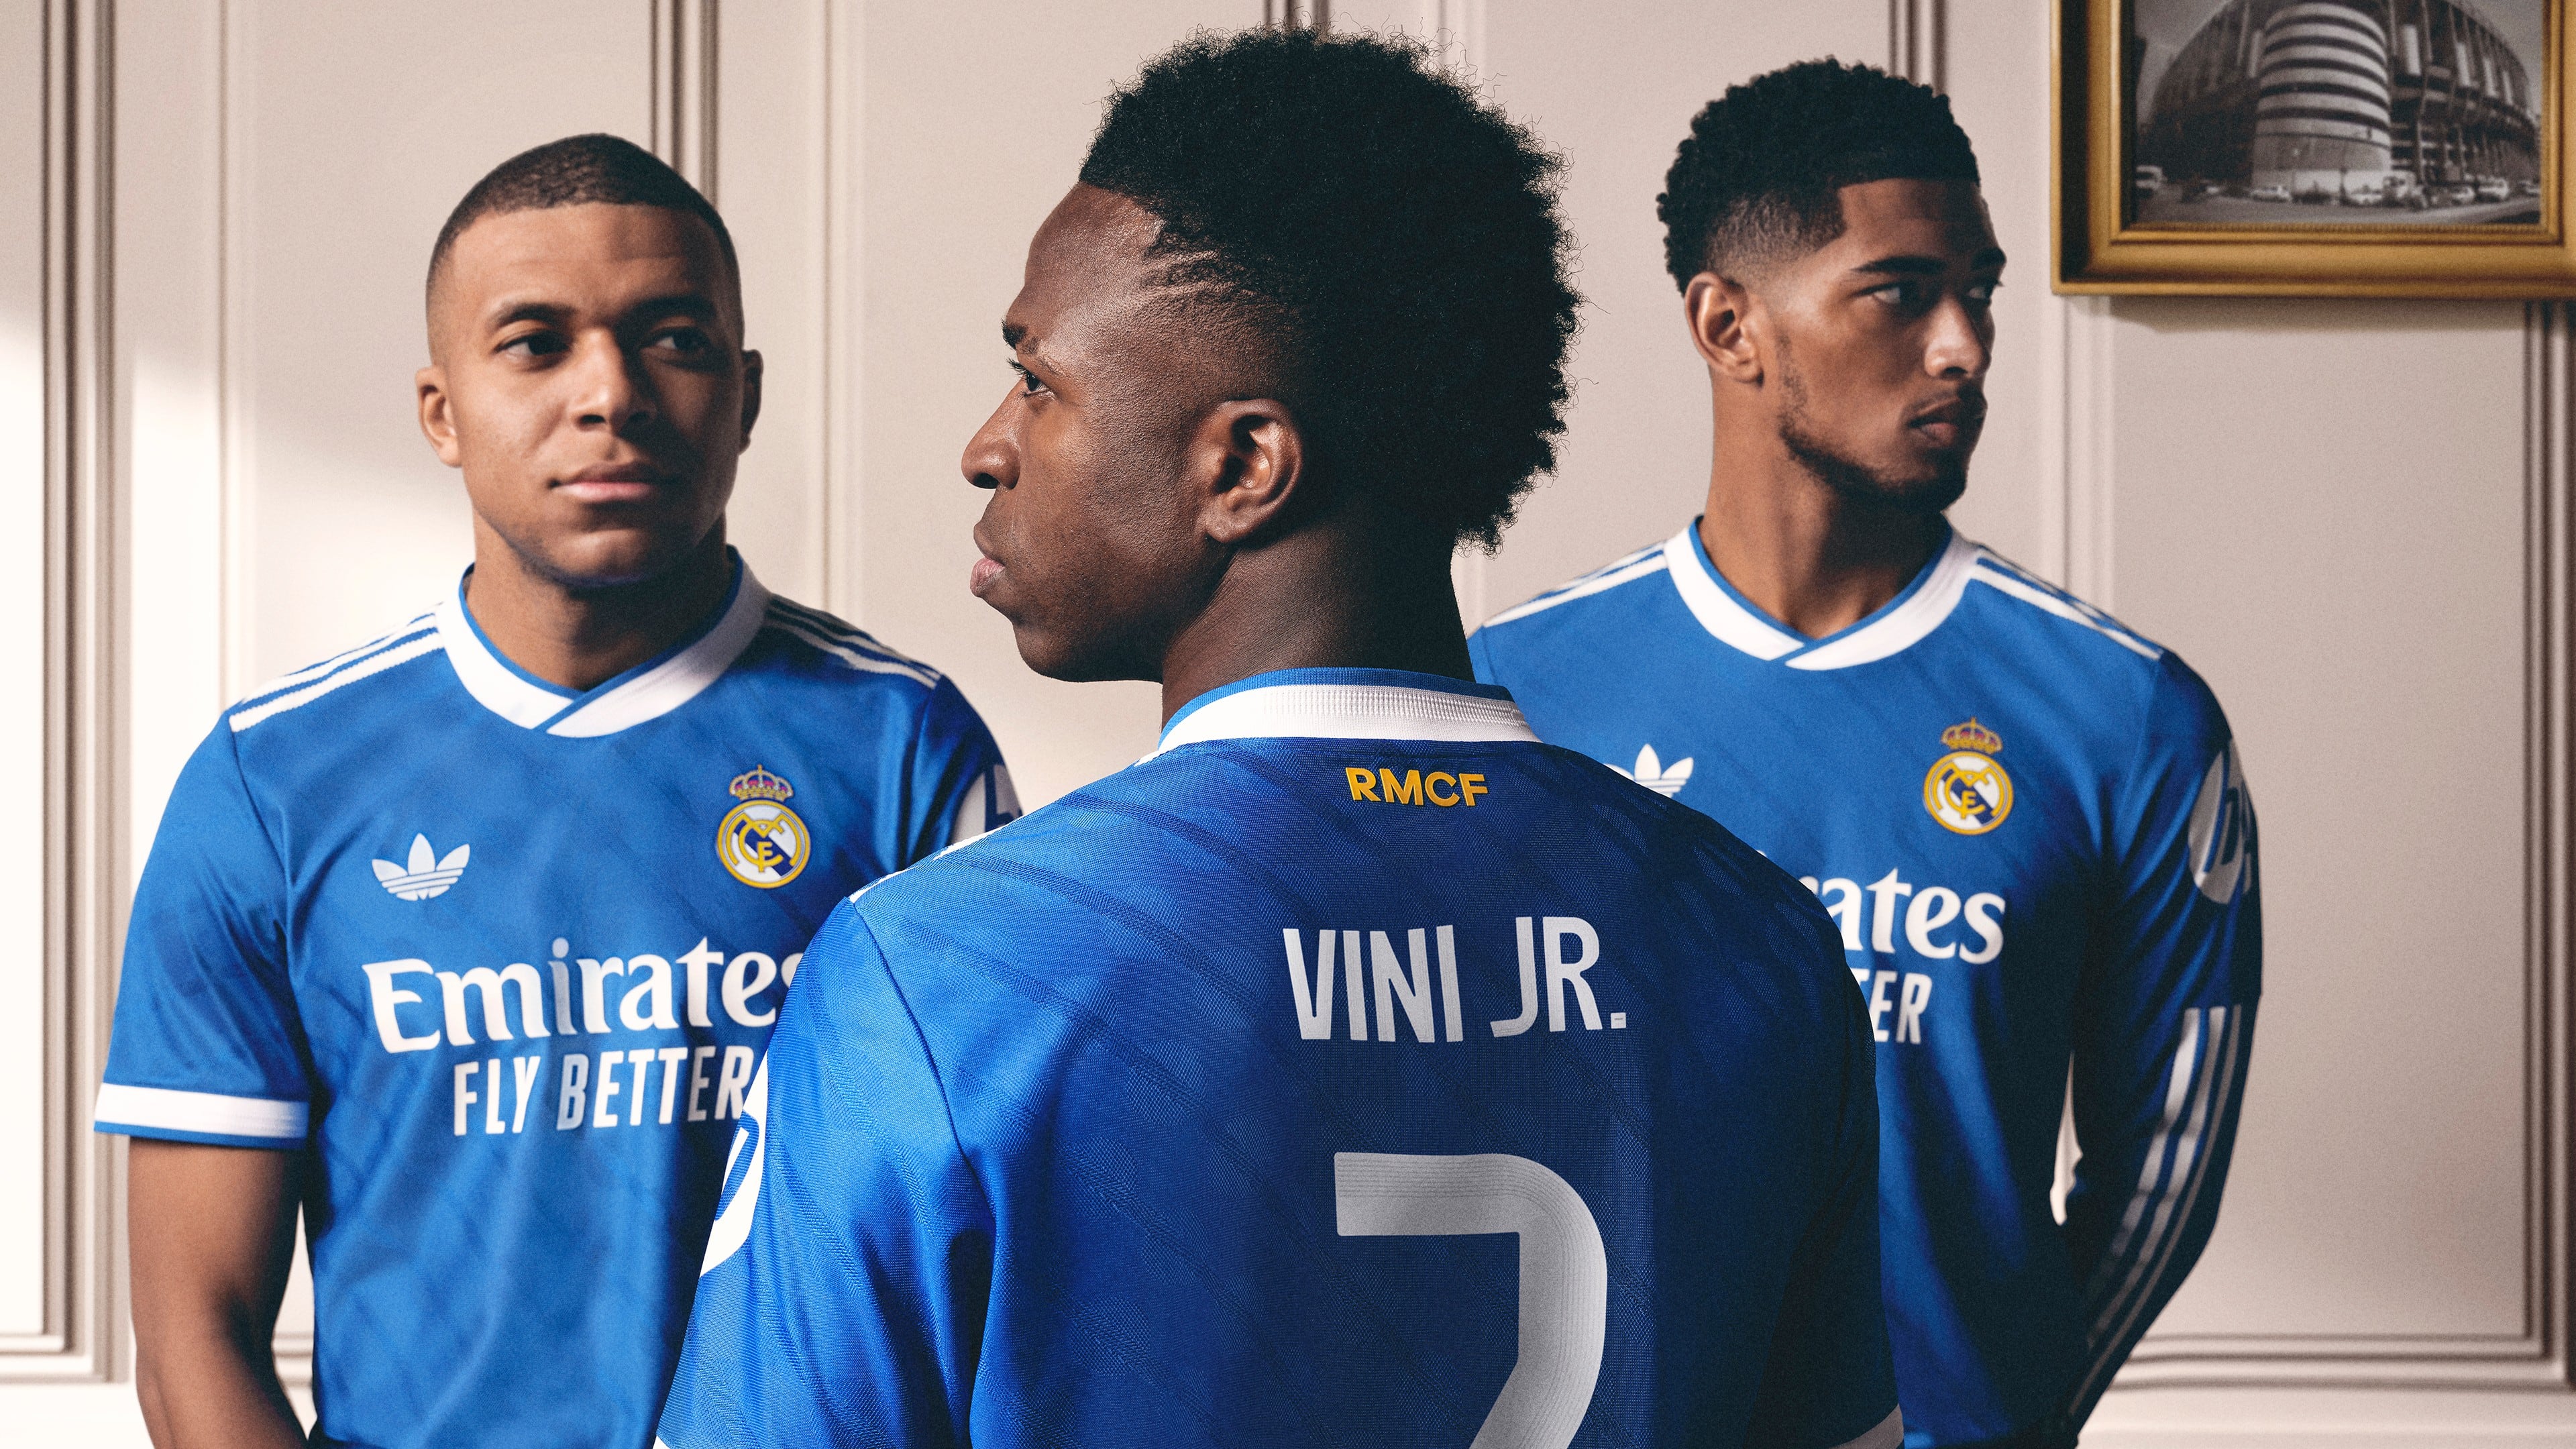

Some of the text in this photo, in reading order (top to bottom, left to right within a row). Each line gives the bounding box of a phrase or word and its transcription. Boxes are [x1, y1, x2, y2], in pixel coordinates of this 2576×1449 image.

[1346, 767, 1488, 807] RMCF
[1799, 867, 2006, 965] ates
[1283, 916, 1626, 1043] VINI JR.
[454, 1045, 754, 1136] FLY BETTER
[1334, 1152, 1607, 1449] 7
